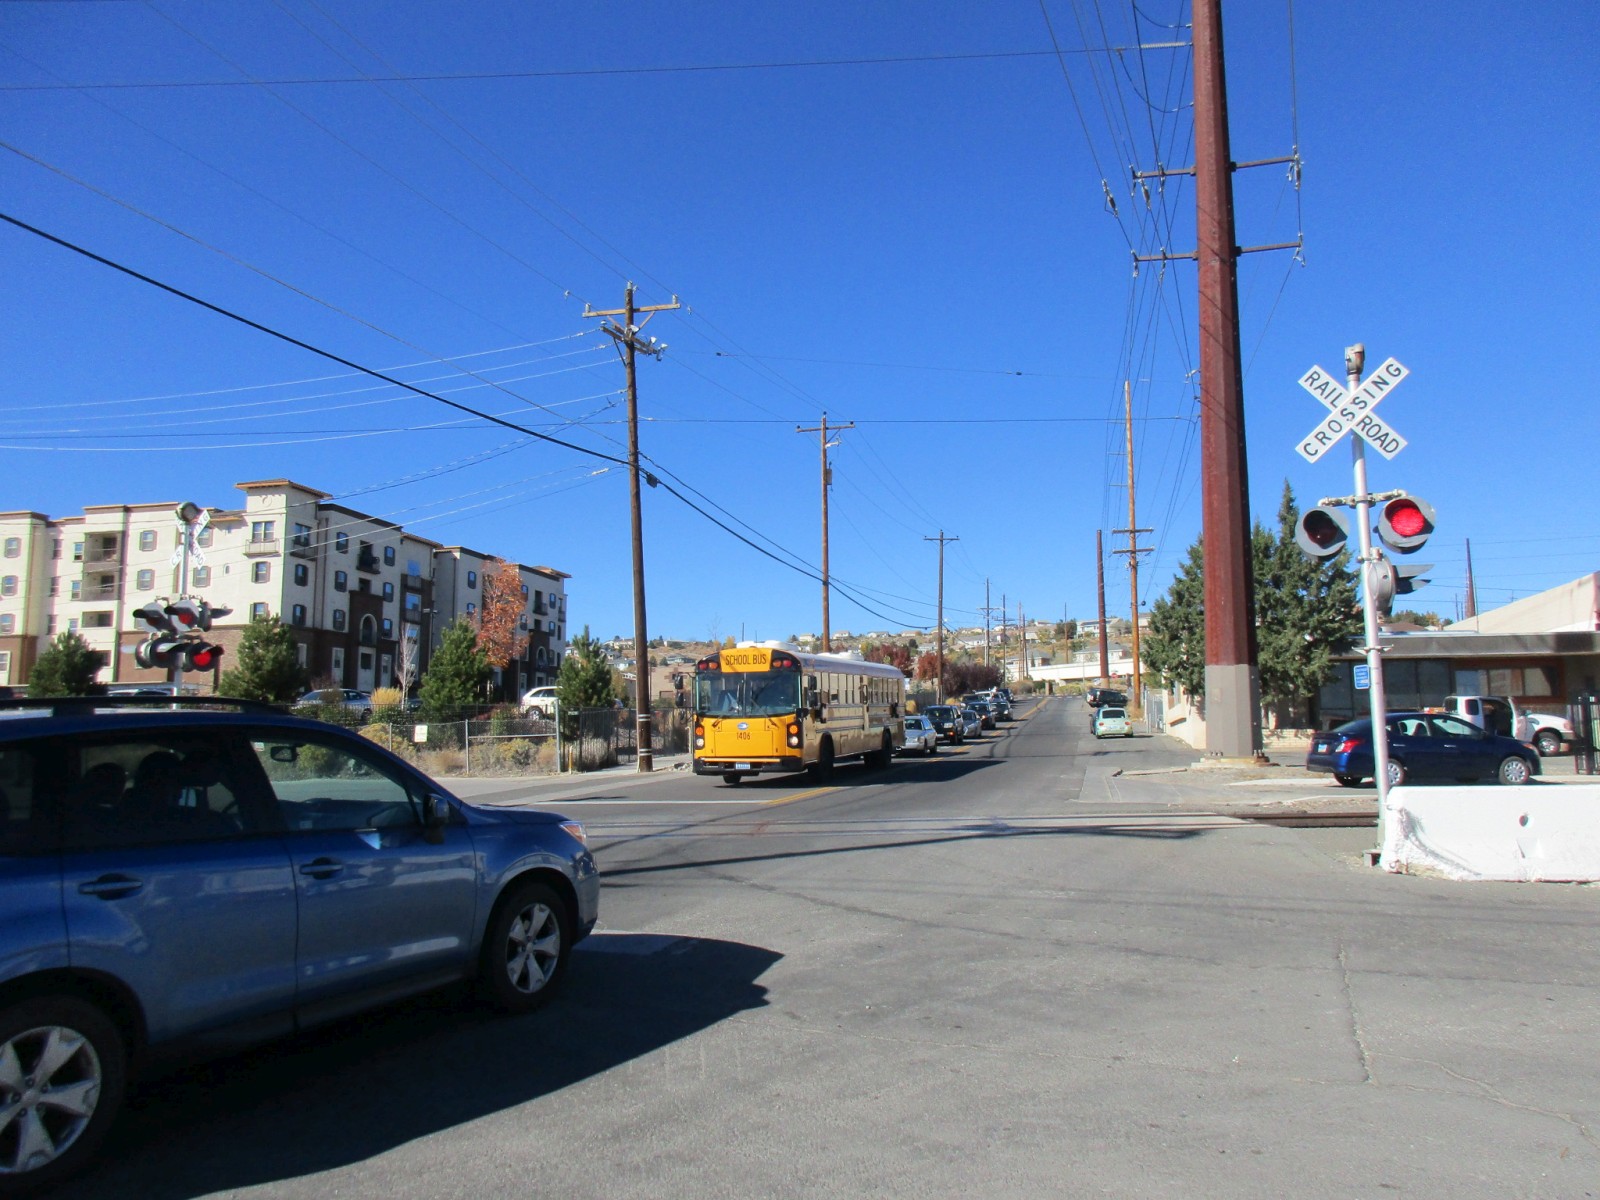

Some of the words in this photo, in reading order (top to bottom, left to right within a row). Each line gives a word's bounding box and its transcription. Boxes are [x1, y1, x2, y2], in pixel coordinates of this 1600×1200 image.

[1303, 363, 1402, 456] CROSSING
[1304, 370, 1343, 409] RAIL
[1355, 414, 1400, 454] ROAD
[725, 654, 751, 666] SCHOOL
[752, 653, 767, 665] BUS
[736, 731, 751, 740] 1406
